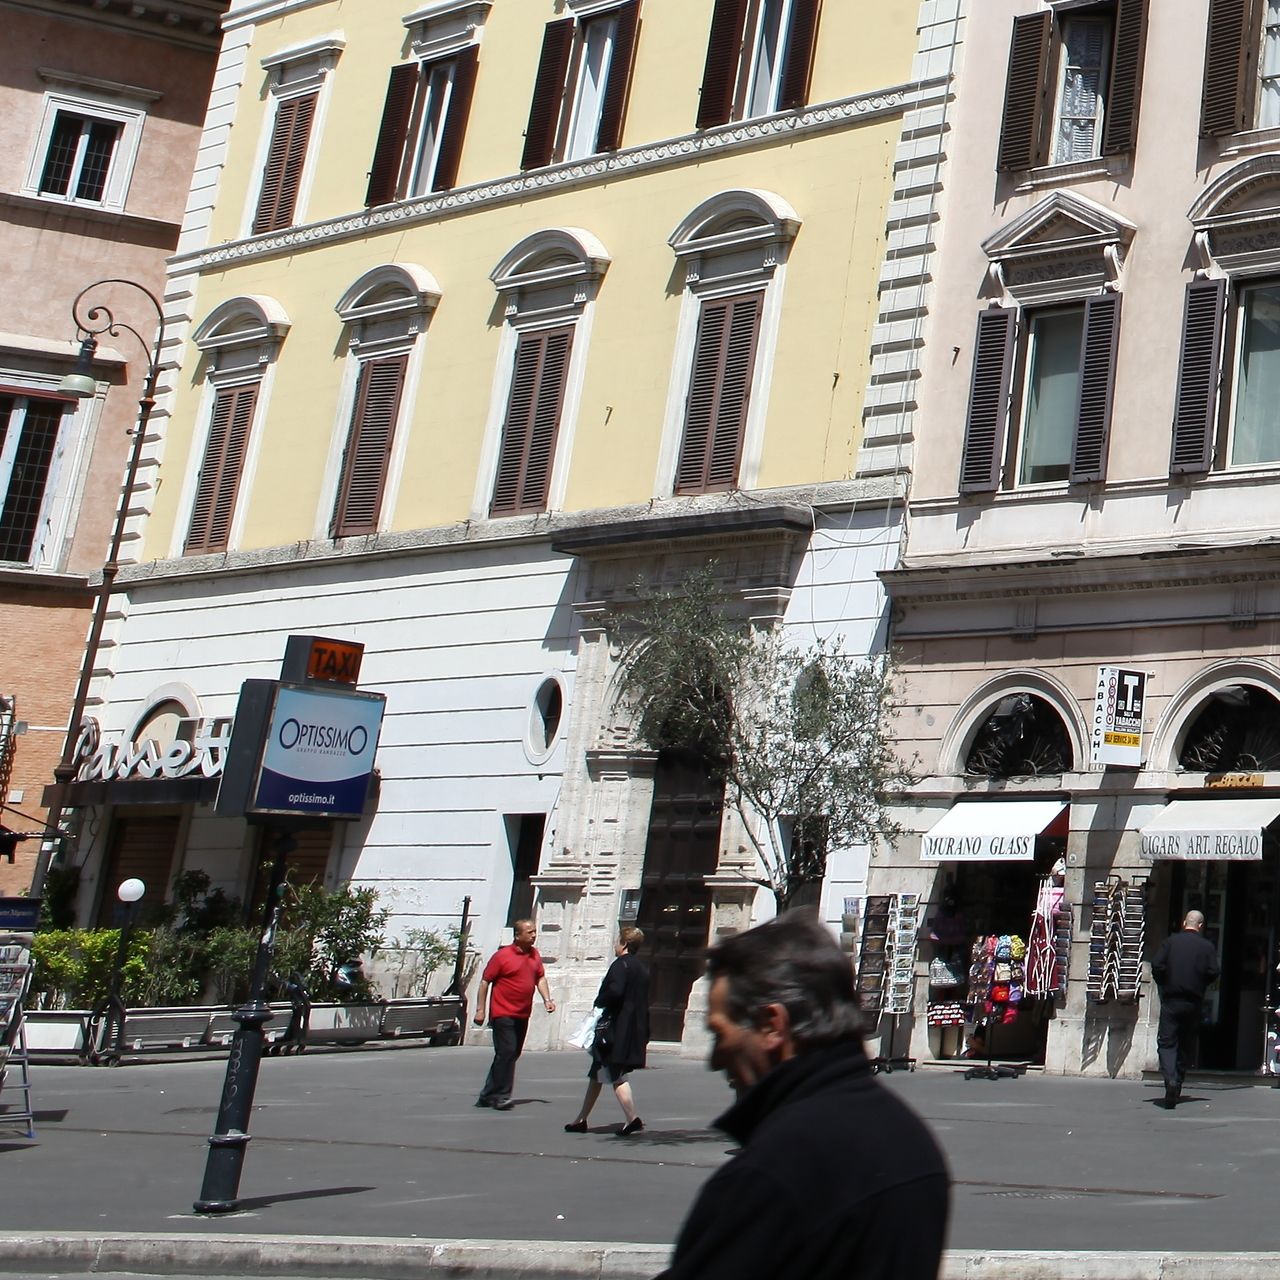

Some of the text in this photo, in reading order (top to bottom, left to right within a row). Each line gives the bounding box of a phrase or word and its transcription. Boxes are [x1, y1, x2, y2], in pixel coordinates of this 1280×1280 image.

[314, 646, 358, 678] TAXI
[1093, 668, 1107, 761] TABACCHI
[279, 718, 368, 756] OPTISSIMO
[288, 792, 336, 805] optissimo.it
[925, 836, 1030, 856] MURANO GLASS
[1141, 835, 1259, 856] CIGARS ART. REGALO
